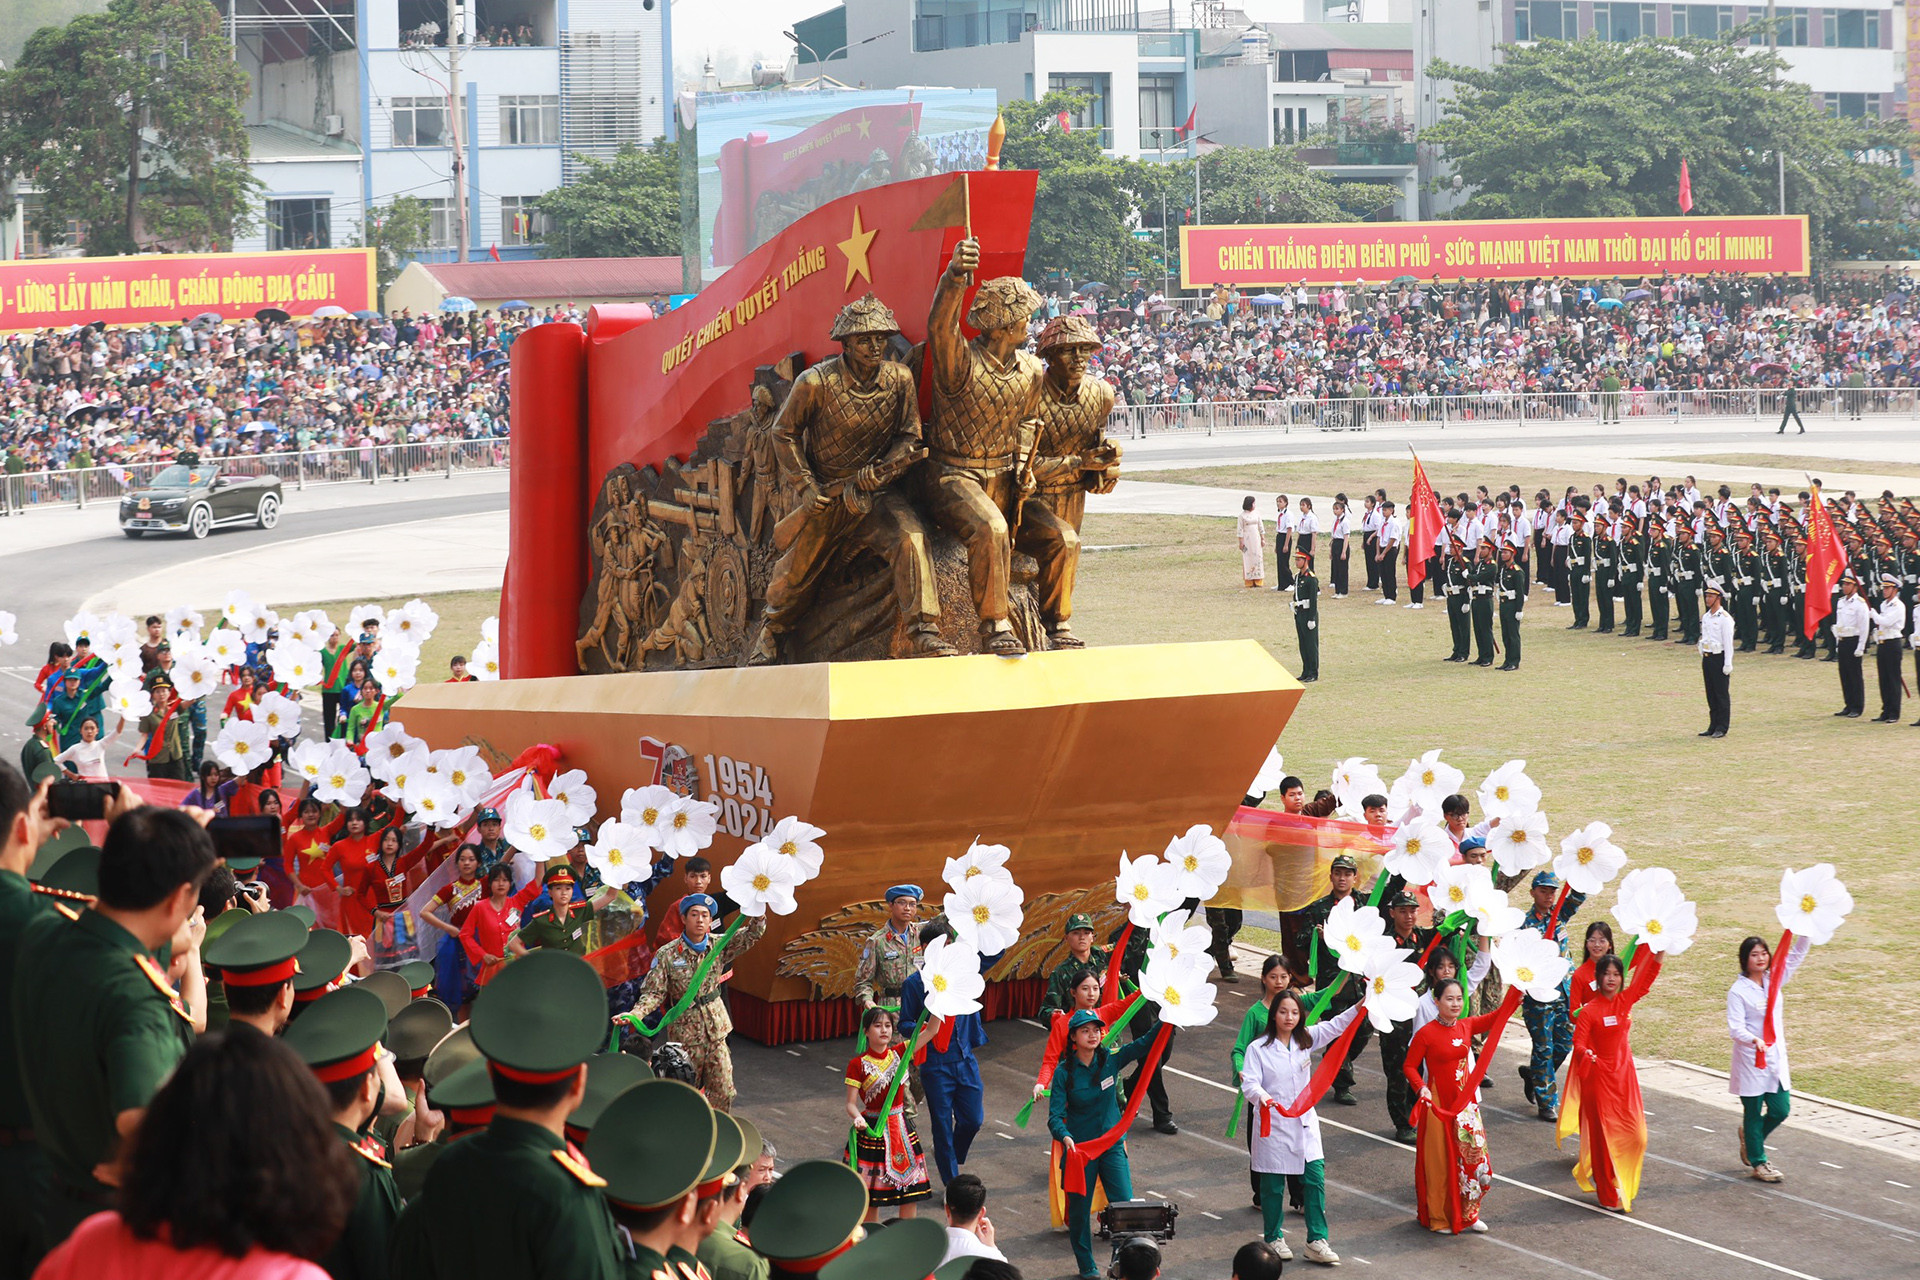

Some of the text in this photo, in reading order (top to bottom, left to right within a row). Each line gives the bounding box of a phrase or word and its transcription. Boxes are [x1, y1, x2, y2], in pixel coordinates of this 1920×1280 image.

[1218, 238, 1264, 271] CHIẾN
[1267, 236, 1317, 270] THẮNG
[1321, 239, 1356, 274] ĐIỆN
[1360, 238, 1396, 268] BIÊN
[1400, 235, 1430, 268] PHỦ
[1445, 236, 1475, 267] SỨC
[1479, 240, 1525, 270] MẠNH
[1528, 234, 1560, 269] VIỆT
[1564, 238, 1599, 263] NAM
[1603, 232, 1637, 262] THỜI
[1641, 237, 1666, 267] ĐẠI
[1670, 229, 1691, 262] HỒ
[1695, 232, 1721, 261] CHÍ
[1725, 235, 1773, 261] MINH!
[16, 278, 57, 314] LỪNG
[59, 272, 87, 311] LẪY
[90, 275, 127, 310] NĂM
[129, 273, 175, 310] CHÂU,
[177, 268, 220, 306] CHẤN
[221, 271, 264, 310] ĐỘNG
[267, 275, 294, 308] ĐỊA
[661, 245, 827, 375] QUYẾT CHIẾN QUYẾT THẮNG
[703, 753, 775, 807] 1954
